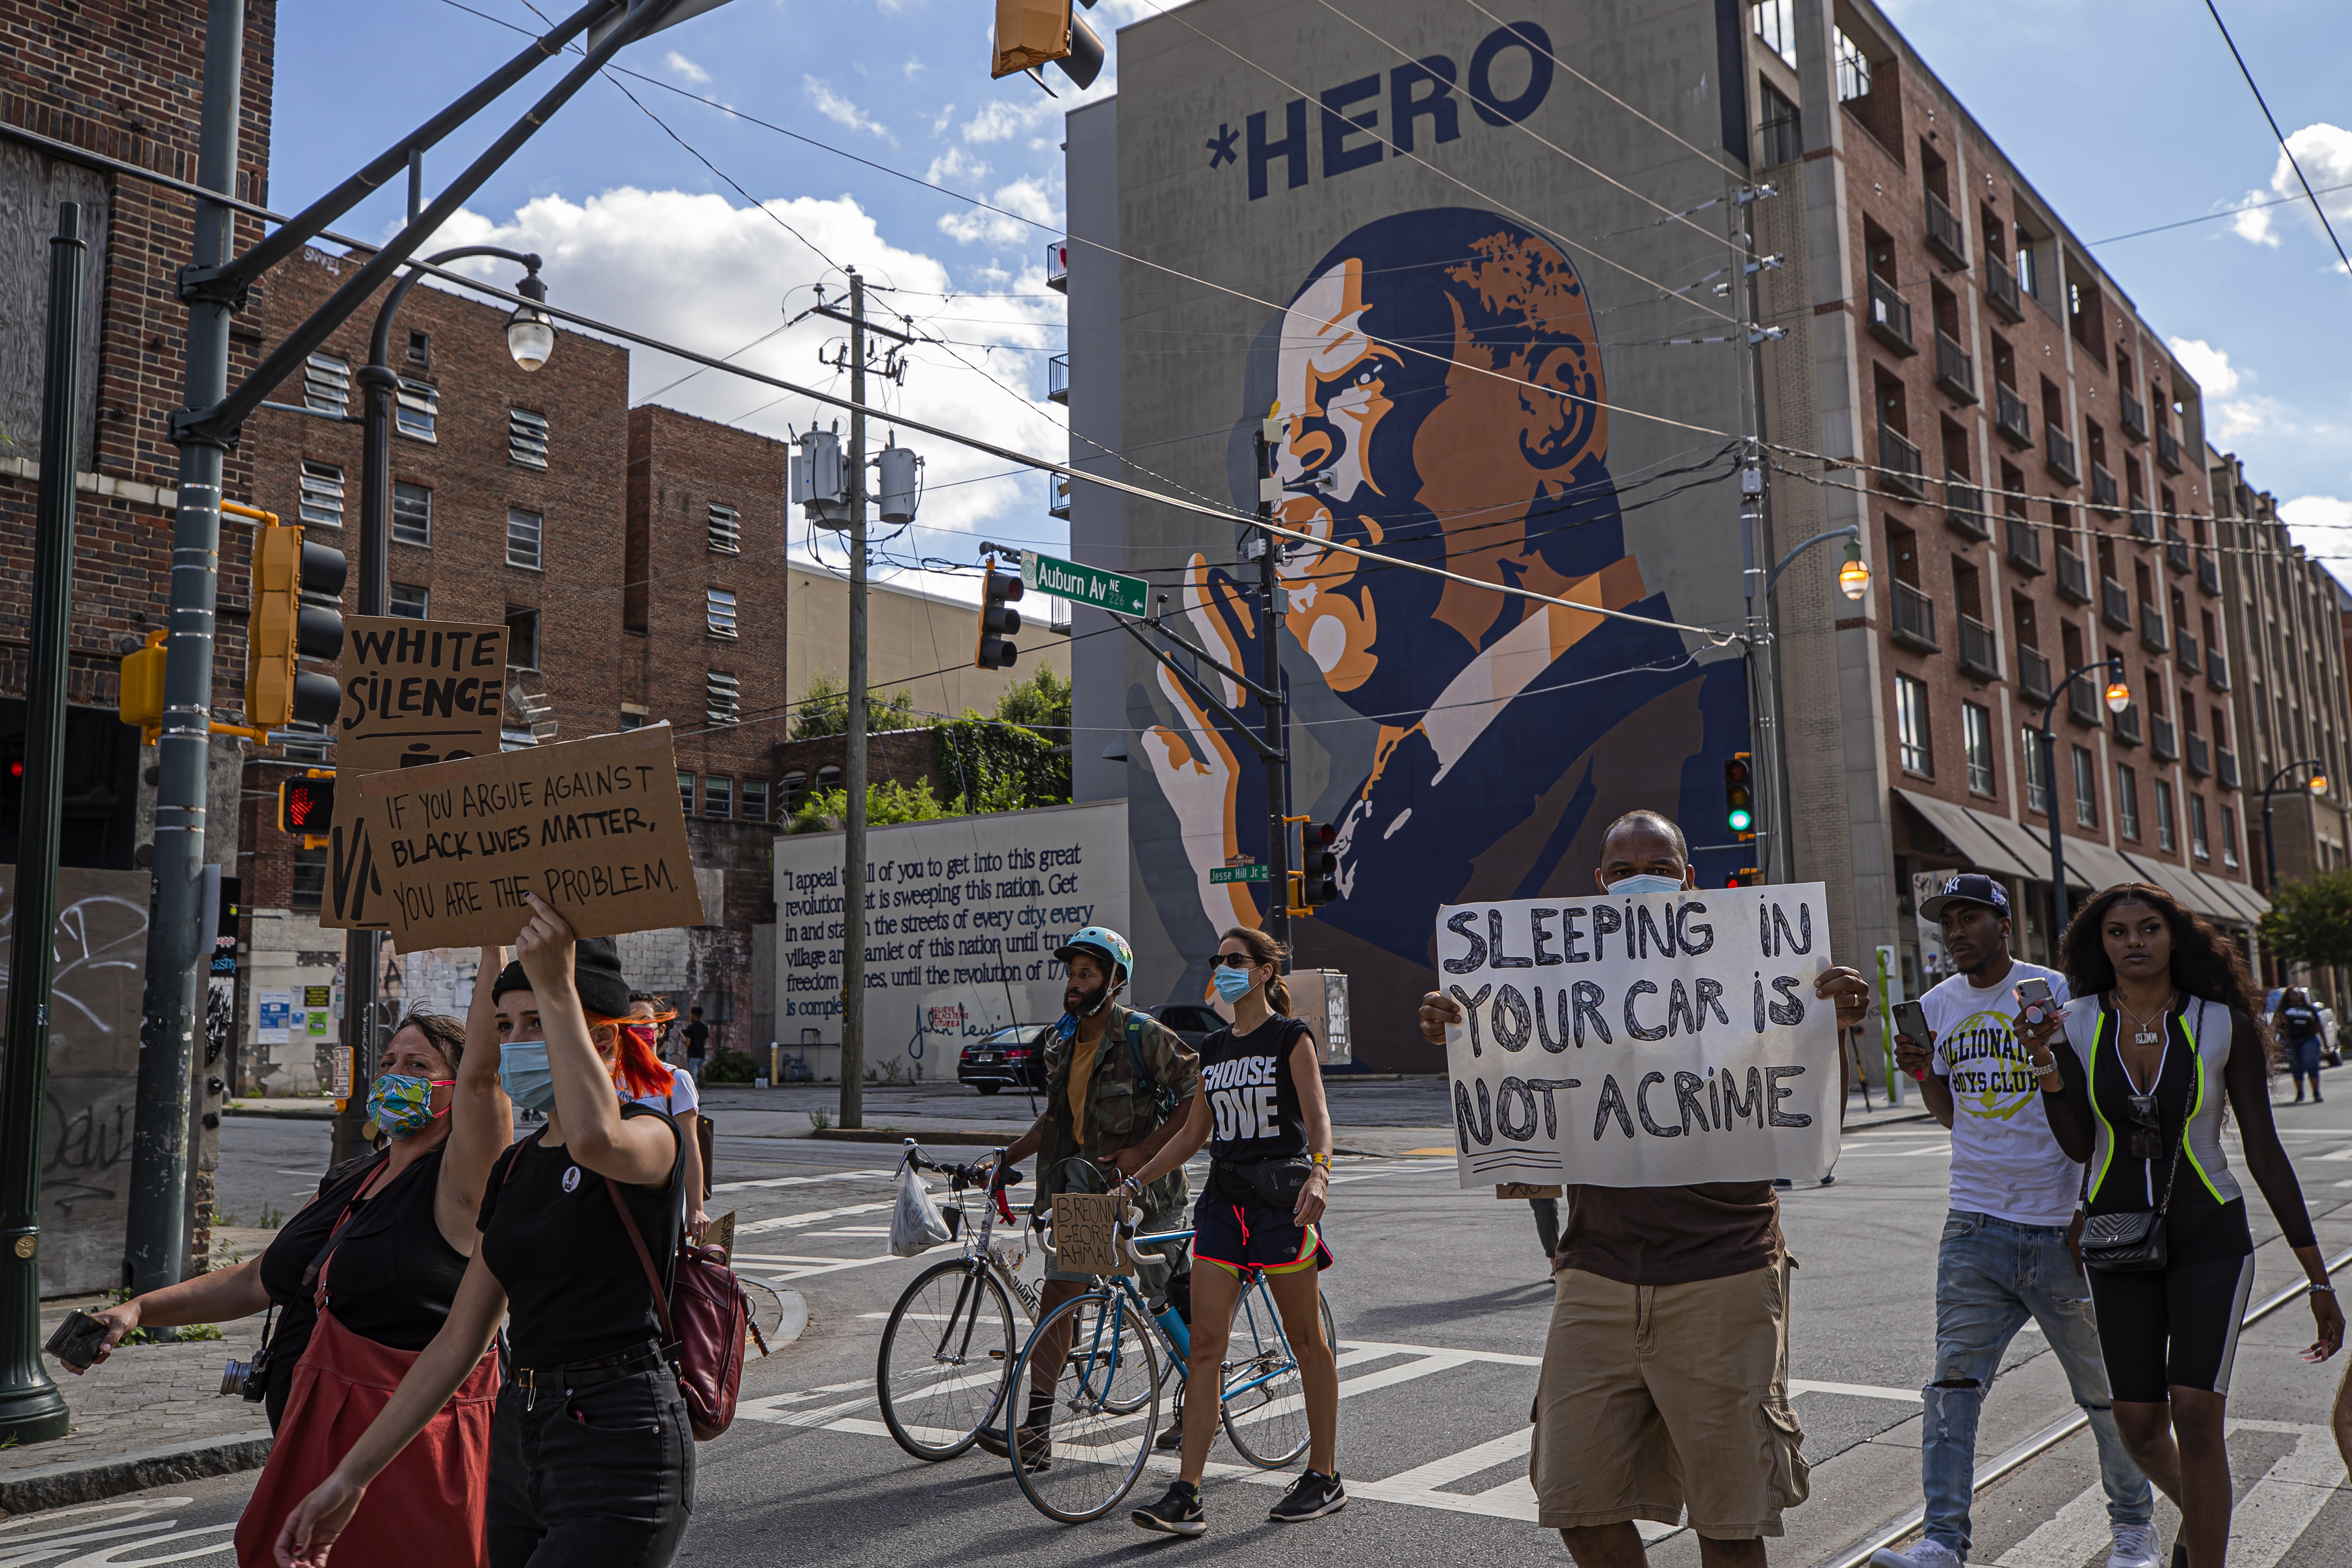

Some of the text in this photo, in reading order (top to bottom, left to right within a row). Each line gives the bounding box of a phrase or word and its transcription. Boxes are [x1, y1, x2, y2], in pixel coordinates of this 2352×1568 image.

[1038, 562, 1119, 600] Auburn Av NE
[1109, 593, 1124, 606] 226
[351, 627, 500, 672] WHITE
[386, 764, 654, 831] IF YOU ARGUE AGAINST
[391, 833, 473, 868] BLACK
[476, 825, 530, 857] LIVES
[796, 866, 837, 895] appeal
[879, 860, 894, 881] of
[897, 861, 924, 884] you
[927, 857, 942, 877] to
[946, 854, 970, 880] get
[974, 851, 1002, 873] into
[1007, 847, 1035, 870] this
[1039, 842, 1082, 872] great
[1211, 871, 1231, 881] Jesse
[1235, 868, 1247, 879] Hill
[1250, 867, 1258, 878] Jr
[393, 858, 679, 931] YOU ARE THE PROBLEM.
[785, 894, 845, 917] revolution
[879, 889, 889, 909] is
[893, 883, 962, 909] sweeping
[965, 879, 992, 900] this
[996, 876, 1044, 899] nation.
[1049, 872, 1078, 895] Get
[785, 923, 798, 942] in
[801, 920, 824, 941] and
[828, 920, 845, 939] sta
[874, 915, 897, 935] the
[900, 910, 949, 933] streets
[953, 908, 969, 929] of
[973, 910, 1014, 932] every
[1017, 905, 1046, 929] city,
[1050, 905, 1094, 927] every
[785, 946, 826, 970] village
[829, 948, 844, 964] an
[865, 941, 905, 962] amlet
[908, 939, 925, 959] of
[928, 936, 954, 958] this
[958, 934, 1002, 955] nation
[1005, 930, 1038, 953] until
[786, 971, 839, 992] freedom
[891, 965, 921, 986] until
[926, 965, 950, 984] the
[953, 962, 1022, 984] revolution
[1026, 960, 1043, 981] of
[786, 998, 795, 1016] is
[1449, 979, 1613, 1058] YOUR
[1624, 978, 1729, 1042] CAR
[2135, 1032, 2158, 1044] SLIMM
[1201, 1056, 1277, 1092] CHOOSE
[1951, 1071, 2039, 1093] BOYS CLUB
[1204, 1086, 1280, 1141] OVE
[1454, 1076, 1582, 1154] NOT
[1593, 1074, 1635, 1142] A
[1057, 1224, 1114, 1245] GEORG
